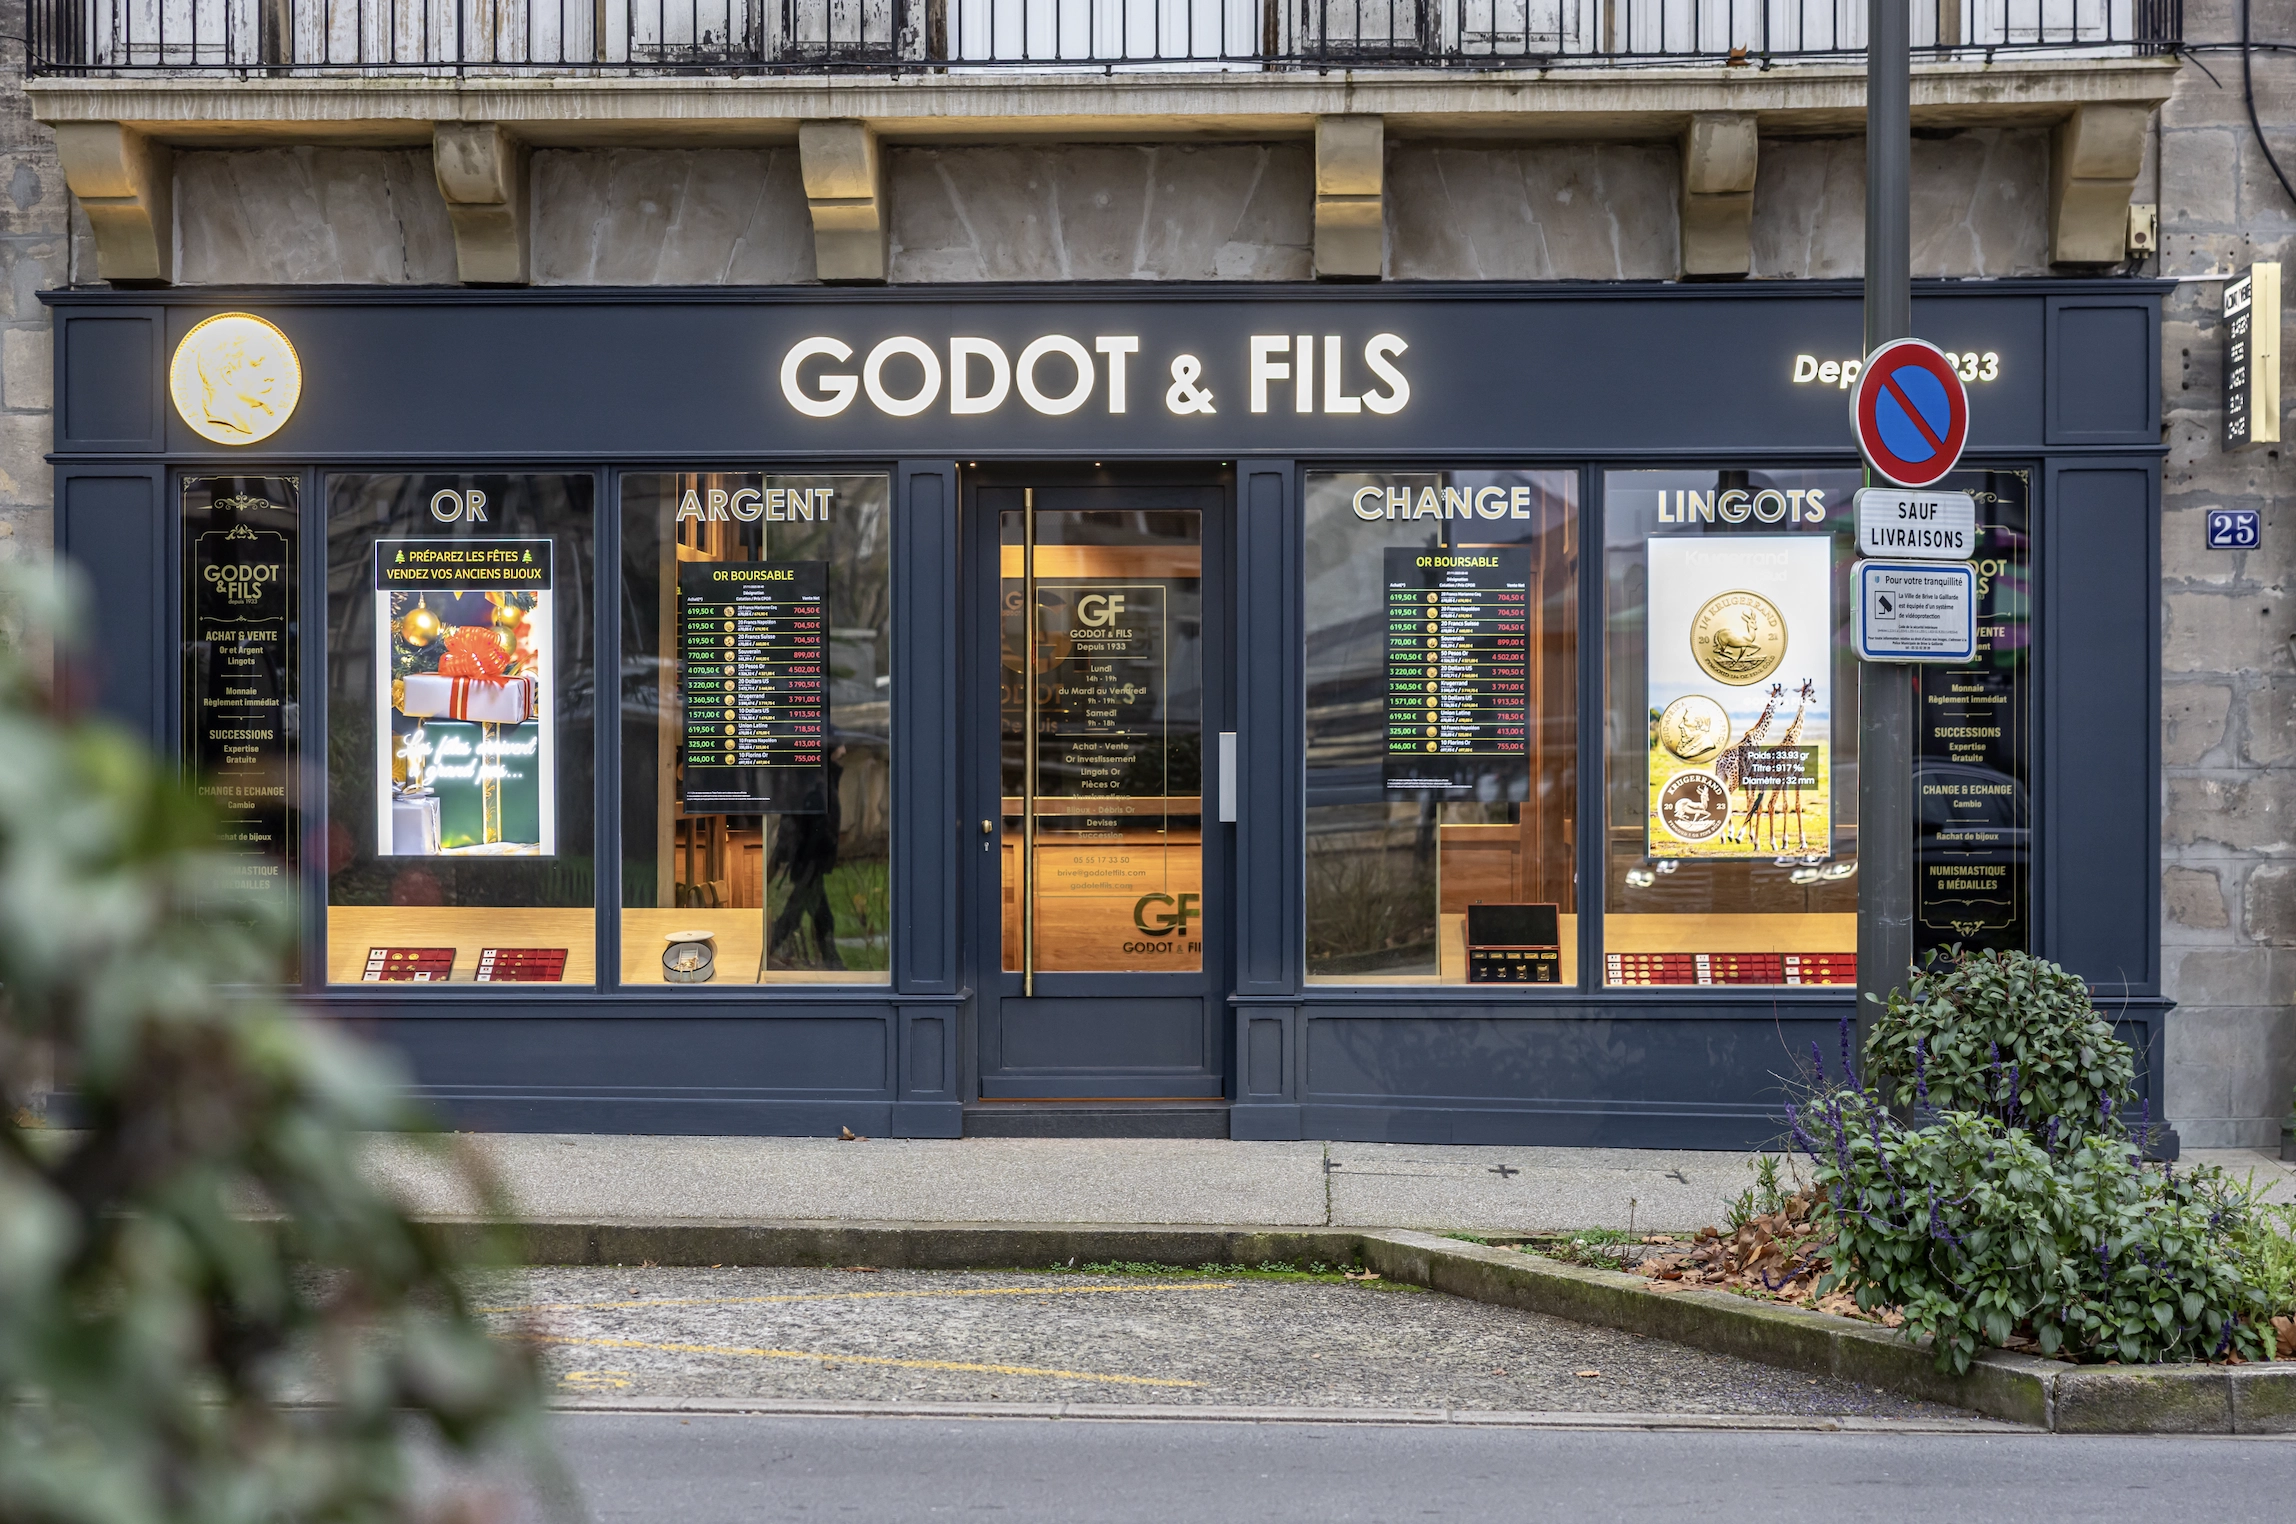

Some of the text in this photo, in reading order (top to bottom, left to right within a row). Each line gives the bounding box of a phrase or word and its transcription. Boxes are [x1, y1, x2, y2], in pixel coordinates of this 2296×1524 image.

[780, 334, 1413, 419] GODOT & FILS
[1793, 354, 1863, 389] Dep
[430, 488, 489, 522] OR
[676, 488, 834, 522] ARGENT
[1352, 485, 1531, 521] CHANGE
[1658, 489, 1827, 523] LINGOTS
[1898, 501, 1938, 520] SAUF
[2214, 515, 2254, 544] 25
[1871, 528, 1963, 548] LIVRAISONS
[409, 550, 519, 562] PRÉPAREZ LES FÊTES
[1416, 557, 1498, 567] OR BOURSABLE
[203, 564, 279, 583] GODOT
[387, 568, 541, 580] VENDEZ VOS ANCIENS BIJOUX
[713, 570, 794, 581] OR BOURSABLE
[1886, 576, 1963, 587] Pour votre tranquillité
[216, 579, 263, 599] & FILS
[1078, 594, 1125, 627] GF
[1710, 597, 1778, 628] KRUGERRAND
[205, 631, 278, 642] ACHAT & VENTE
[1070, 629, 1105, 638] GODOT
[1116, 629, 1132, 638] FILS
[1699, 636, 1710, 644] 20
[219, 645, 264, 655] Or et Argent
[1077, 643, 1105, 651] Depuis
[227, 656, 255, 666] Lingots
[1091, 665, 1112, 673] Lundi
[225, 686, 257, 696] Monnaie
[1059, 687, 1069, 695] du
[1071, 687, 1095, 695] Mardi
[1109, 687, 1146, 695] Vendredi
[1951, 683, 1984, 693] Monnaie
[203, 697, 280, 708] Règlement immédiat
[1928, 694, 2008, 705] Règlement immédiat
[209, 729, 274, 740] SUCCESSIONS
[1934, 726, 2001, 739] SUCCESSIONS
[223, 744, 259, 754] Expertise
[1949, 742, 1987, 752] Expertise
[226, 754, 257, 764] Gratuite
[1800, 753, 1809, 761] gr
[1951, 753, 1983, 763] Gratuite
[423, 759, 478, 785] grand
[1081, 768, 1108, 777] Lingots
[1667, 773, 1723, 796] KRUGERRAND
[1786, 777, 1796, 785] 32
[199, 786, 284, 796] CHANGE & ECHANGE
[1923, 784, 2013, 796] CHANGE & ECHANGE
[227, 800, 255, 809] Cambio
[1953, 799, 1982, 809] Cambio
[1067, 806, 1090, 814] Bijoux
[249, 833, 272, 842] bijoux
[1936, 831, 1999, 842] Rachat de bijoux
[1929, 864, 2006, 877] NUMISMASTIQUE
[1937, 878, 1998, 890] & MÉDAILLES
[1134, 893, 1200, 936] GF
